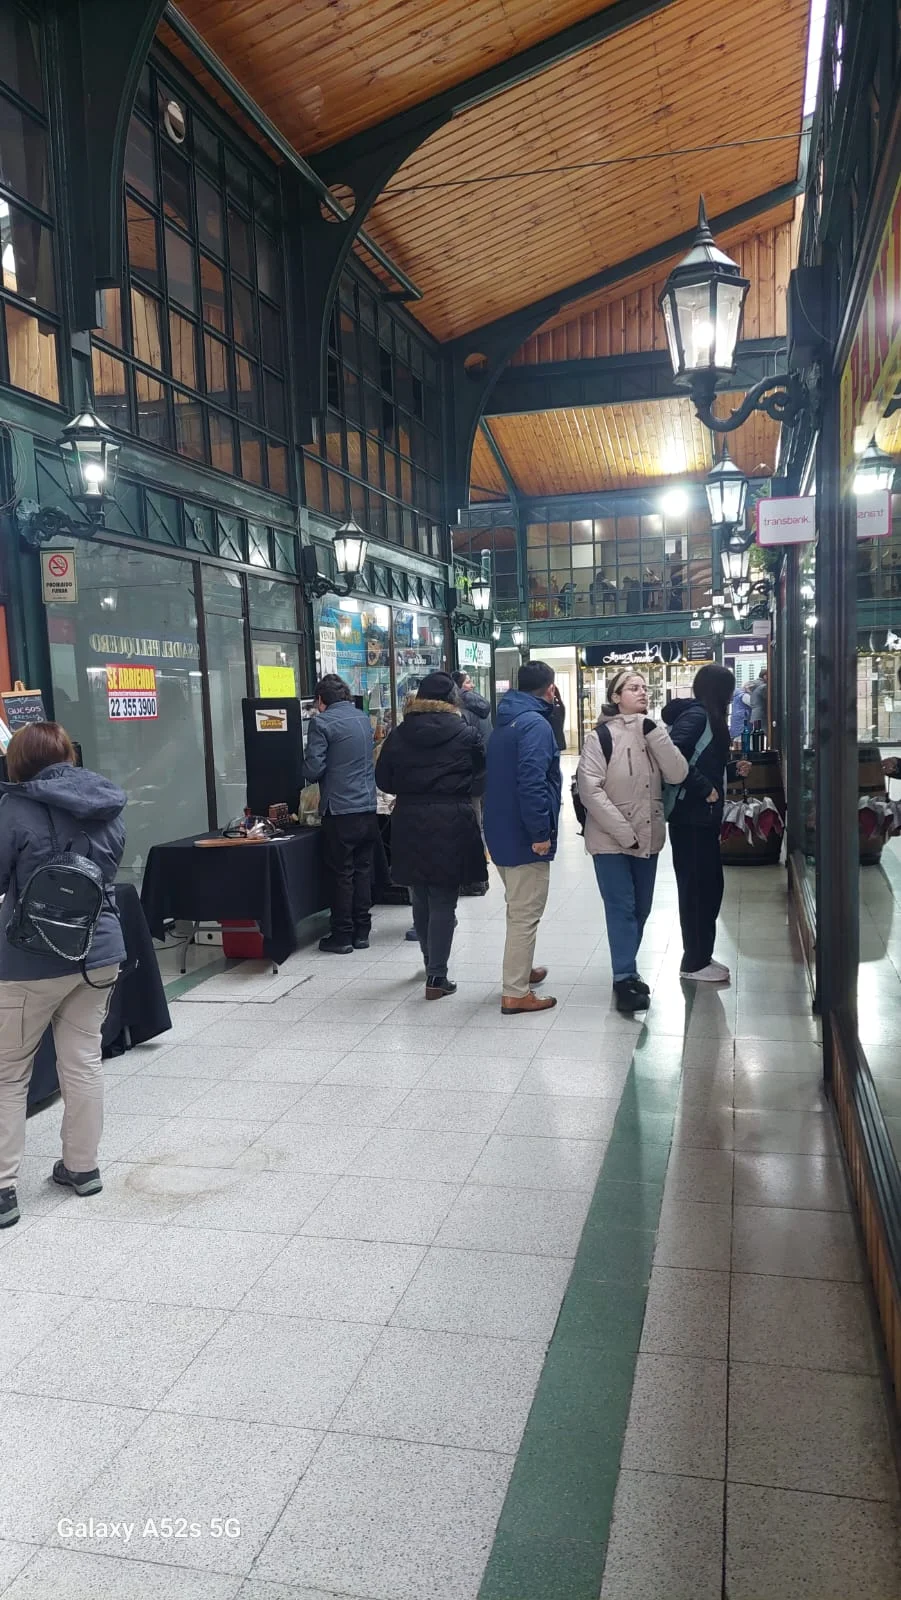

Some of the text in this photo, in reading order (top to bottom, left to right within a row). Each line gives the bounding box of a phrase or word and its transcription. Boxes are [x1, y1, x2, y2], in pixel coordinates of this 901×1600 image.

[764, 514, 809, 526] transbank
[107, 667, 156, 690] SE ARRIENDA
[110, 698, 156, 717] 22 355 3900
